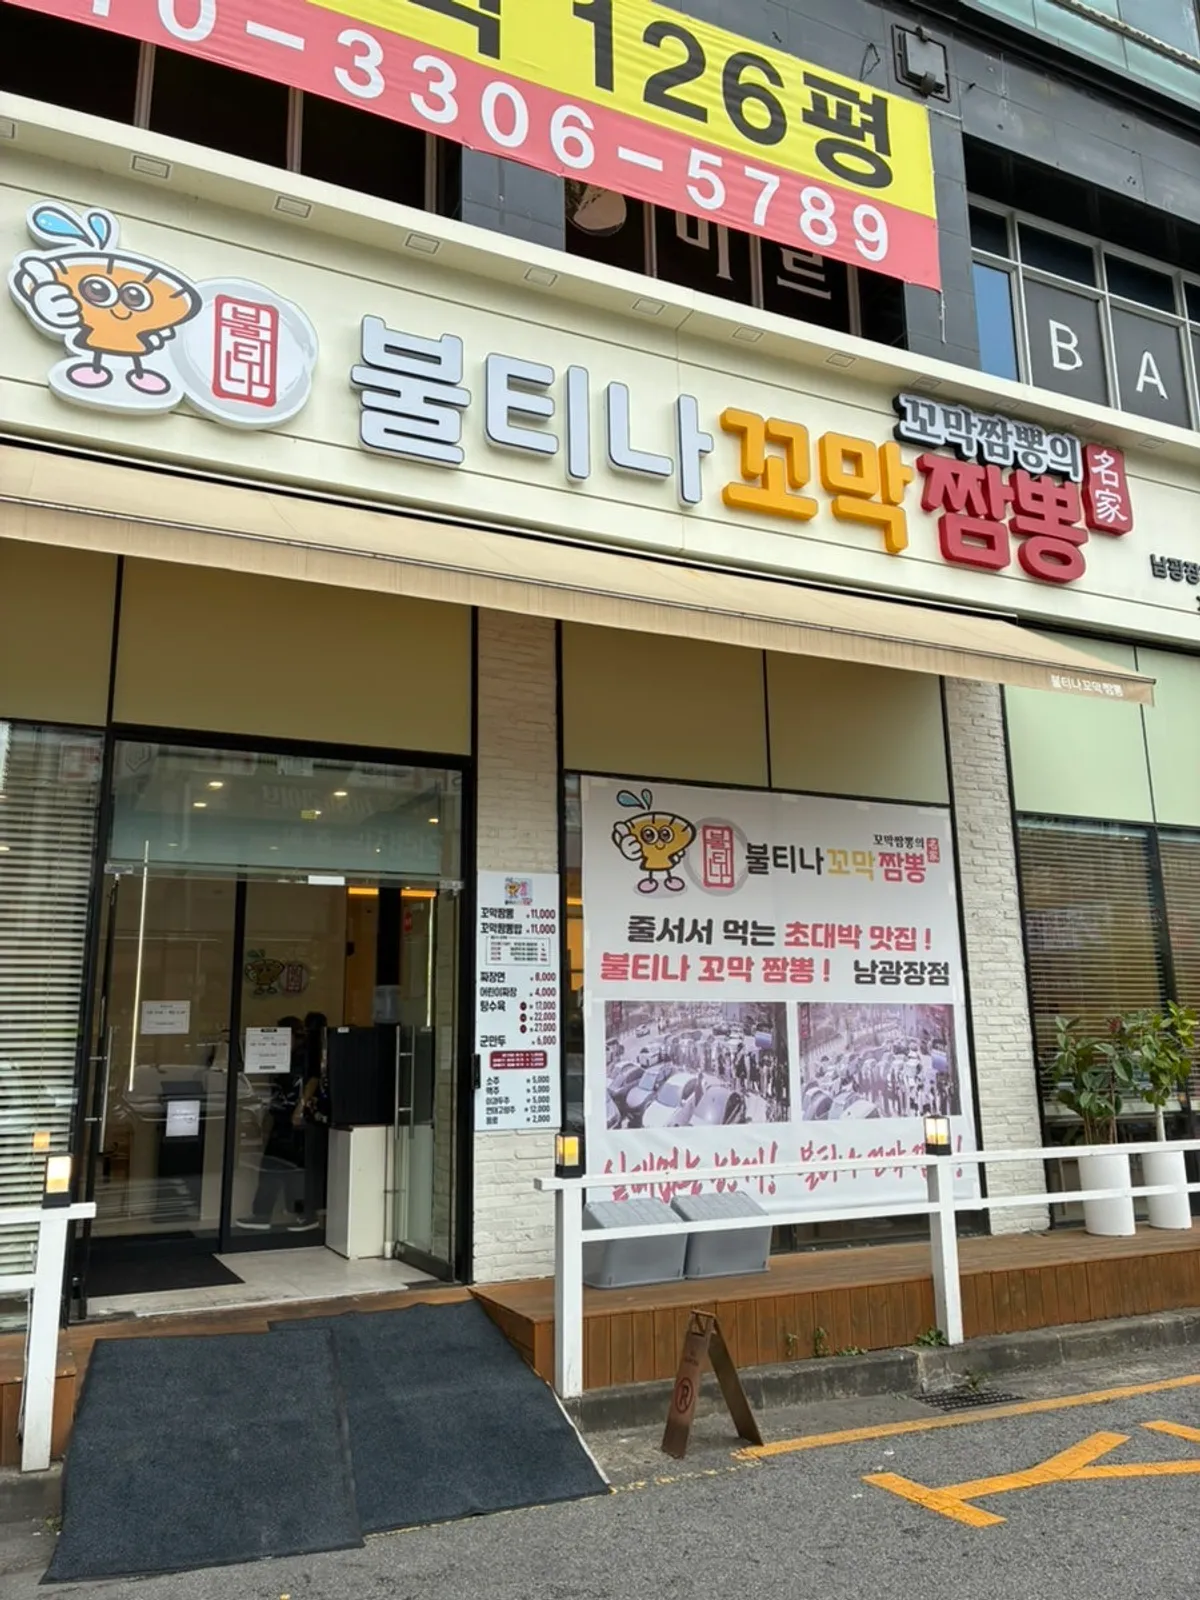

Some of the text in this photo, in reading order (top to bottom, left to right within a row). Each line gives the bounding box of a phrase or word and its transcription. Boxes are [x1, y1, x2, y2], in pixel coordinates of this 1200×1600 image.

[350, 314, 714, 508] 불티나
[894, 394, 1083, 484] 꼬막짬뽕의
[1090, 450, 1128, 523] 名家
[745, 843, 824, 876] 불티나
[627, 915, 714, 945] 줄서서
[723, 920, 776, 947] 먹는
[784, 920, 862, 950] 초대박
[600, 952, 690, 982] 불티나
[697, 955, 755, 983] 꼬막
[853, 959, 951, 987] 남광장점
